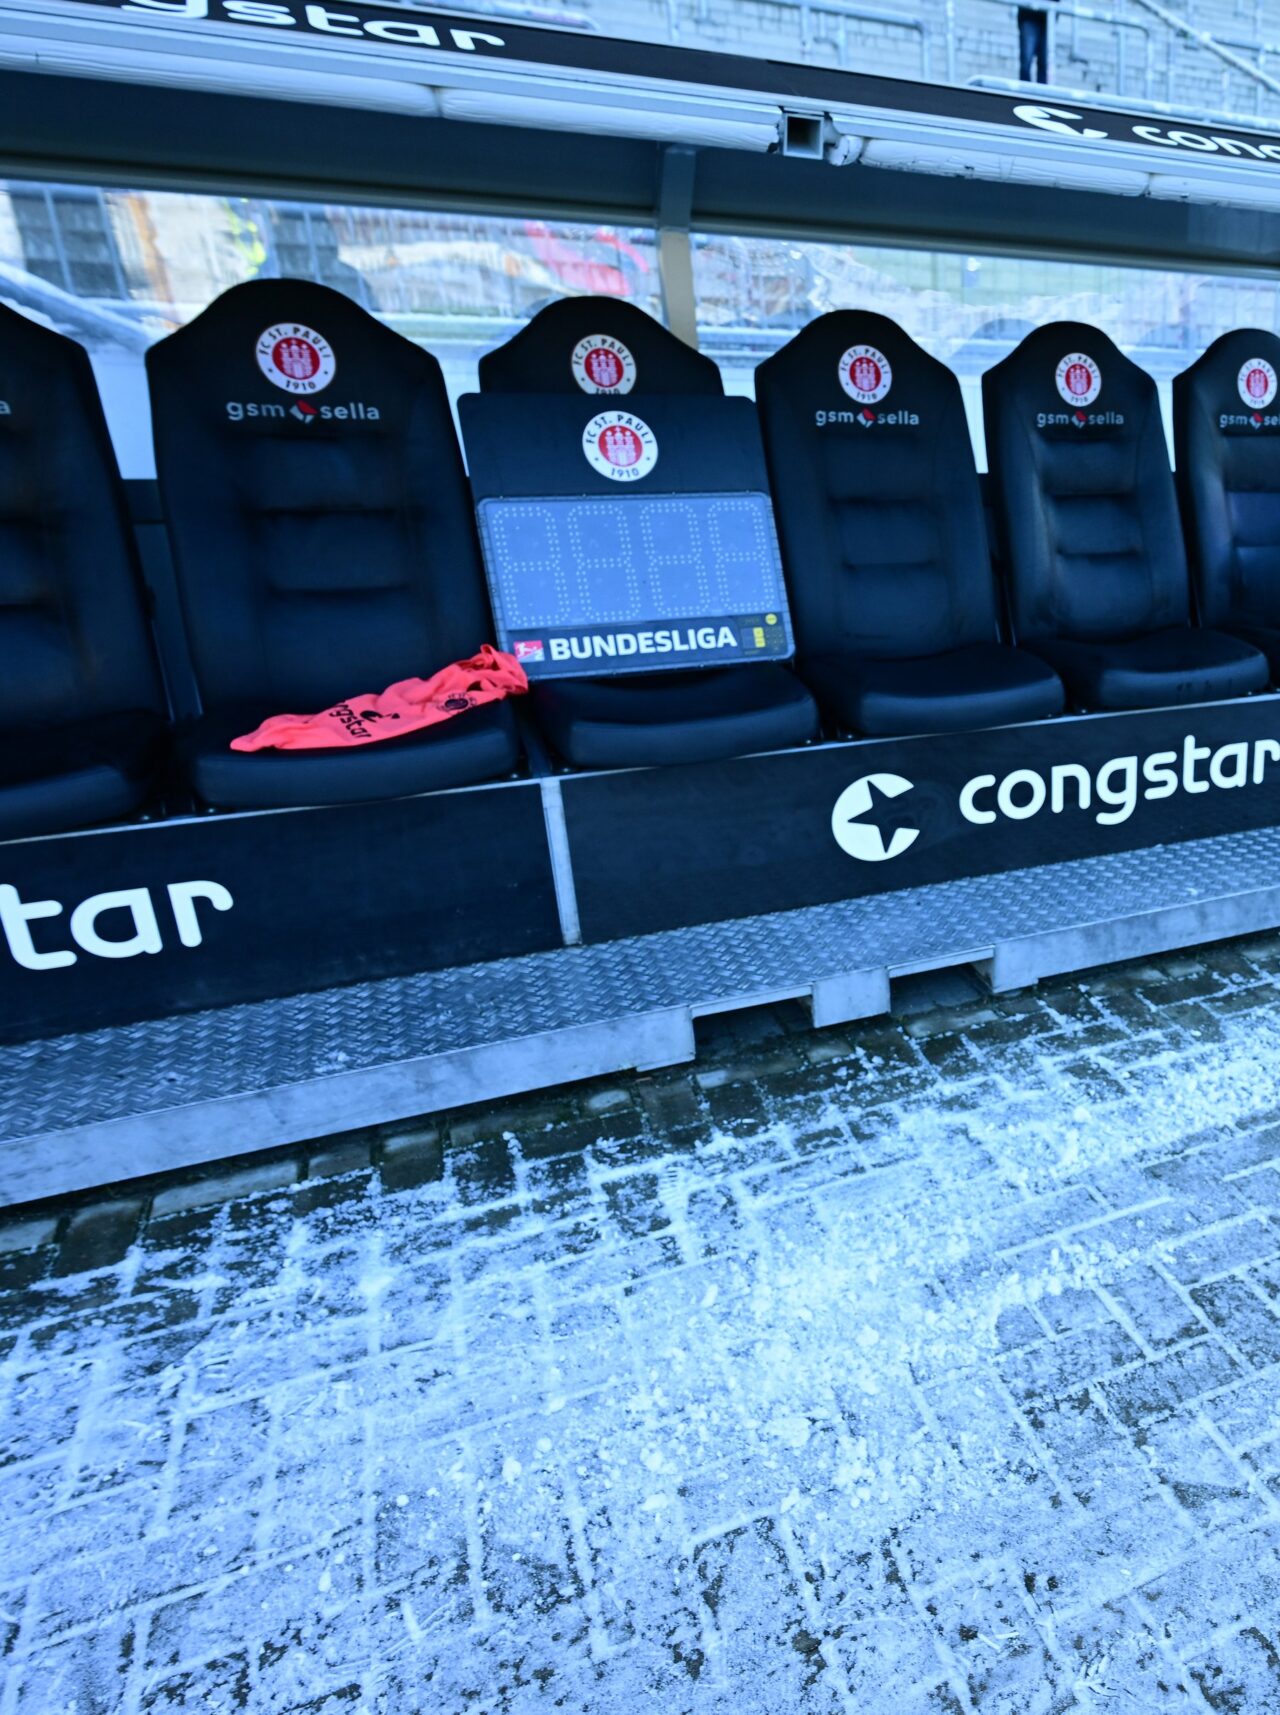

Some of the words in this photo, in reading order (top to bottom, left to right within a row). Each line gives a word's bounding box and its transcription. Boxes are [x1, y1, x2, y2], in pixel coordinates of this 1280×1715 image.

[293, 326, 332, 359] PAULI
[601, 338, 634, 367] PAULI
[285, 380, 316, 391] 1910
[226, 401, 285, 421] gsm
[320, 402, 380, 420] sella
[815, 410, 854, 427] gsm
[877, 409, 920, 425] sella
[1037, 412, 1069, 428] gsm
[1088, 411, 1125, 425] sella
[585, 431, 597, 444] FC
[616, 414, 653, 444] PAULI
[1220, 414, 1248, 429] gsm
[611, 468, 639, 478] 1910
[549, 626, 738, 661] BUNDESLIGA
[0, 880, 234, 970] tar
